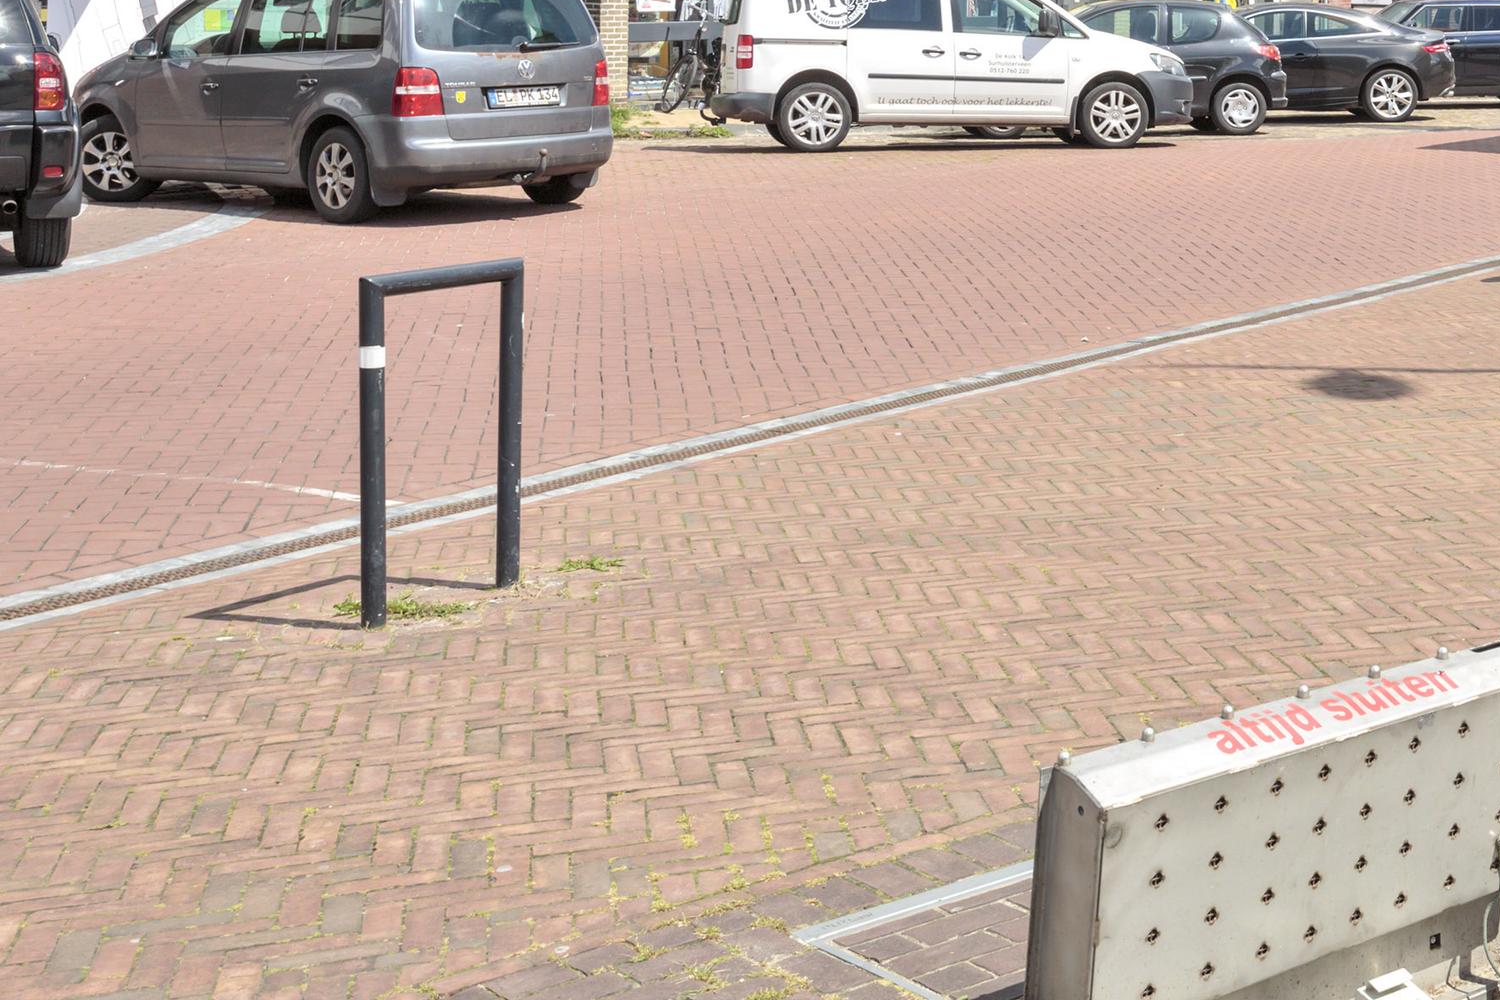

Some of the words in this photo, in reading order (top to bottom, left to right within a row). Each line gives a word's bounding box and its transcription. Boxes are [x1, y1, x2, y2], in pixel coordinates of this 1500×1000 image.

[496, 90, 513, 103] EL
[520, 88, 535, 101] PK
[538, 87, 558, 100] 134
[887, 97, 915, 107] gaat
[916, 97, 939, 105] toch
[941, 97, 958, 105] ook
[962, 98, 984, 106] voor
[987, 97, 1003, 106] het
[1207, 703, 1322, 755] altijd
[1320, 671, 1459, 722] sluiten
